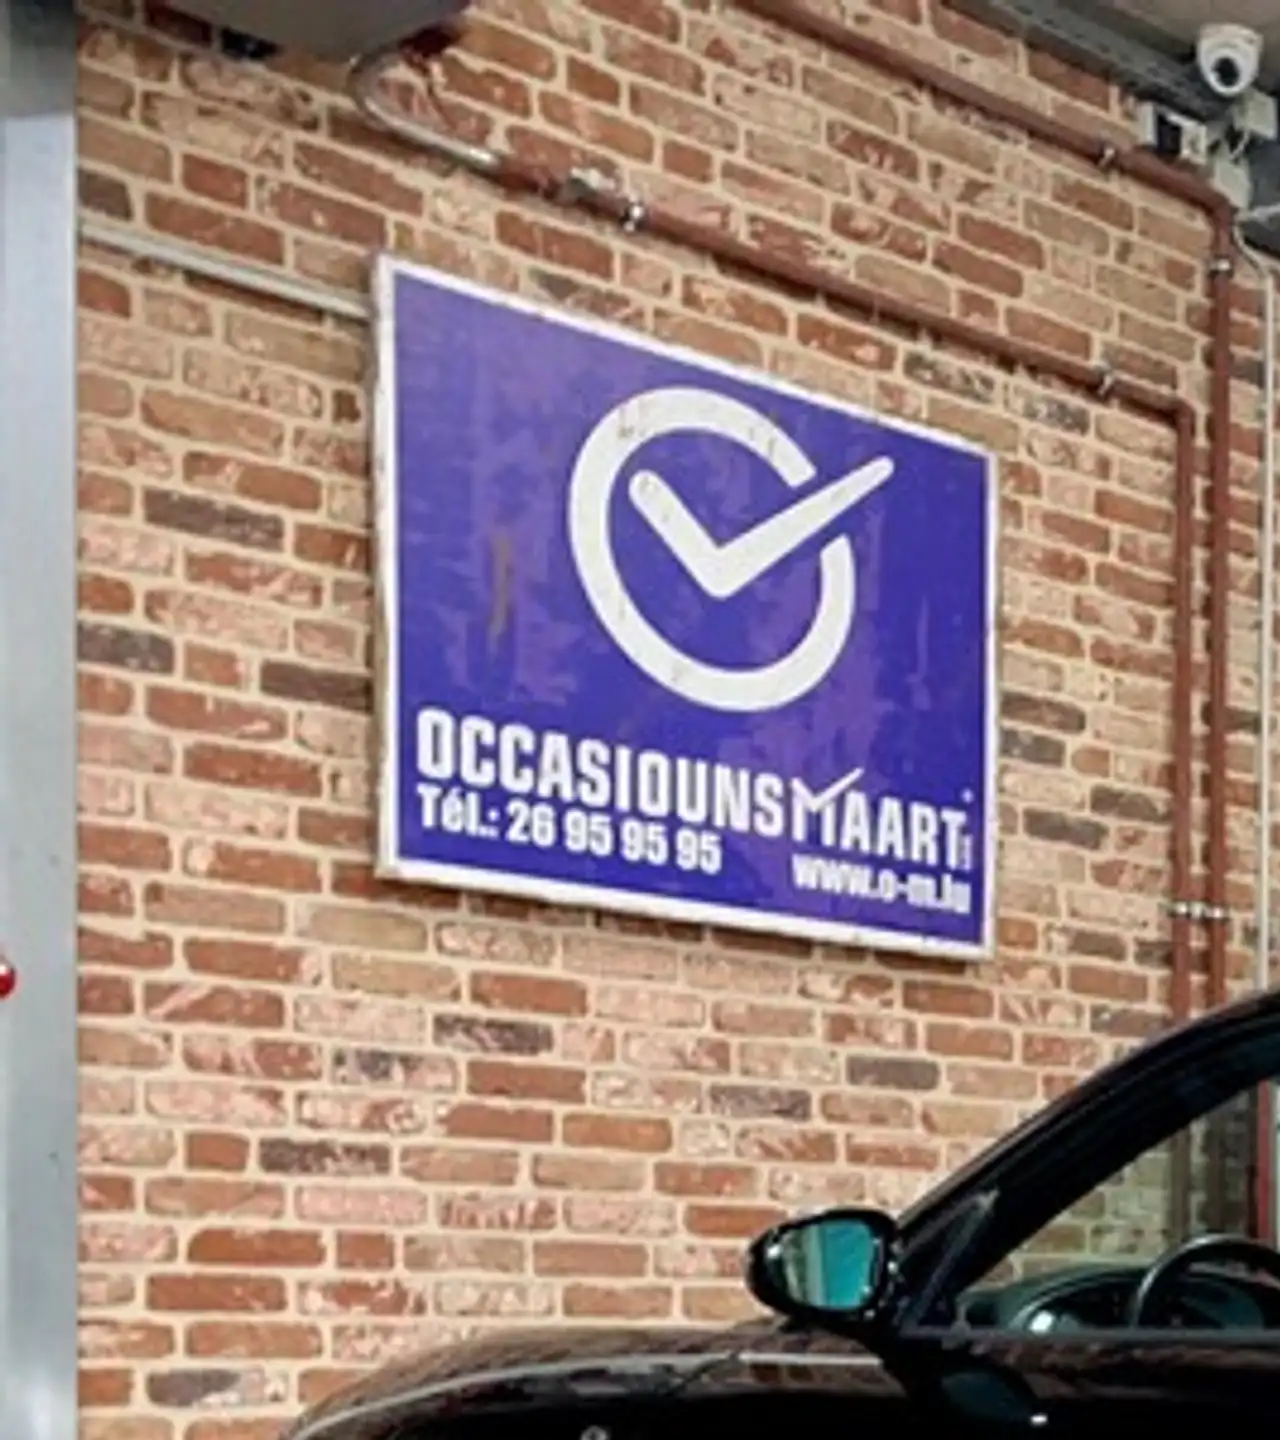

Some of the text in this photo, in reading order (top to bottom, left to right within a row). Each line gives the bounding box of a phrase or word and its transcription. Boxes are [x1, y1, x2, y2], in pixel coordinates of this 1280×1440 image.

[416, 707, 968, 870] OCCASIOUNSMAART
[505, 797, 557, 848] 26
[563, 808, 615, 857] 95
[620, 818, 669, 867] 95
[674, 828, 723, 876] 95
